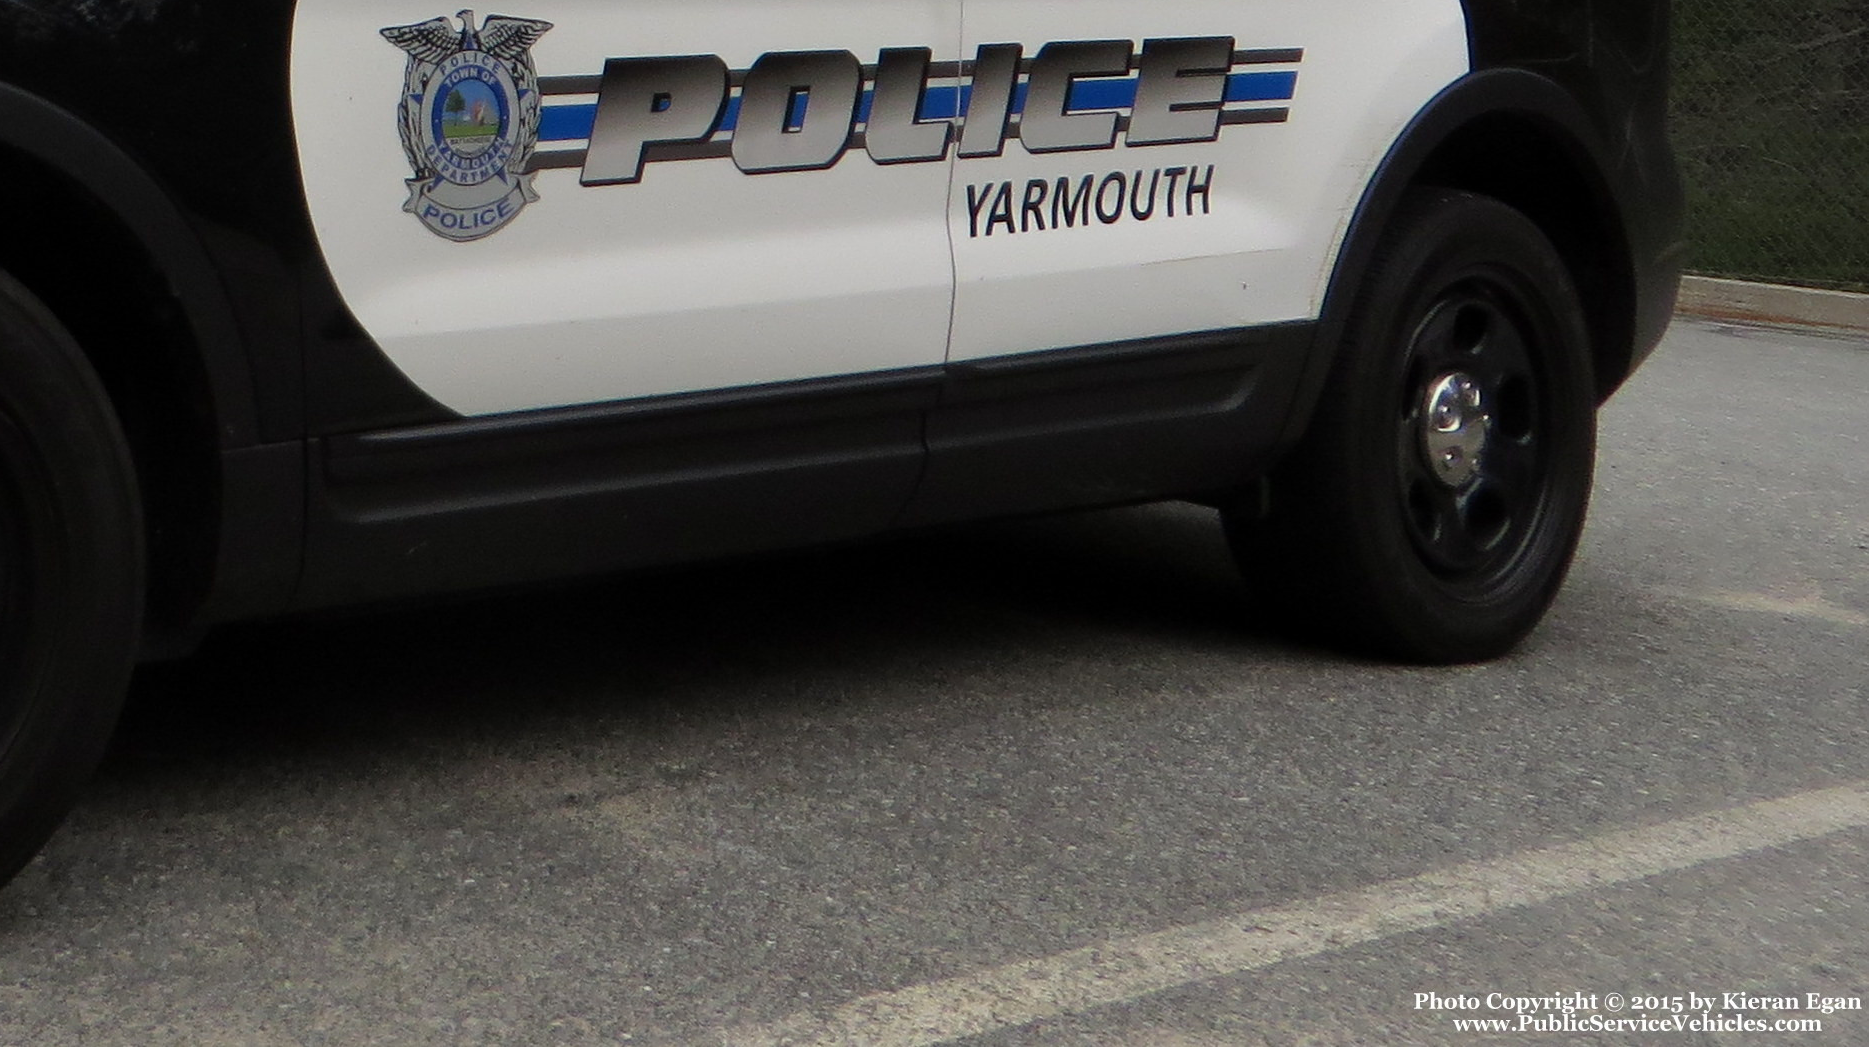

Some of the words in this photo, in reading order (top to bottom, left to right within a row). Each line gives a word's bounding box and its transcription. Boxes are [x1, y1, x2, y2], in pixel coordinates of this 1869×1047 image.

[439, 53, 501, 76] POLICE
[445, 66, 479, 88] TOWN
[481, 69, 497, 85] OF
[578, 36, 1236, 187] POLICE
[426, 140, 513, 184] DEPARTMENT
[437, 136, 505, 169] YARMOUTH
[422, 196, 515, 230] POLICE
[965, 164, 1215, 239] YARMOUTH
